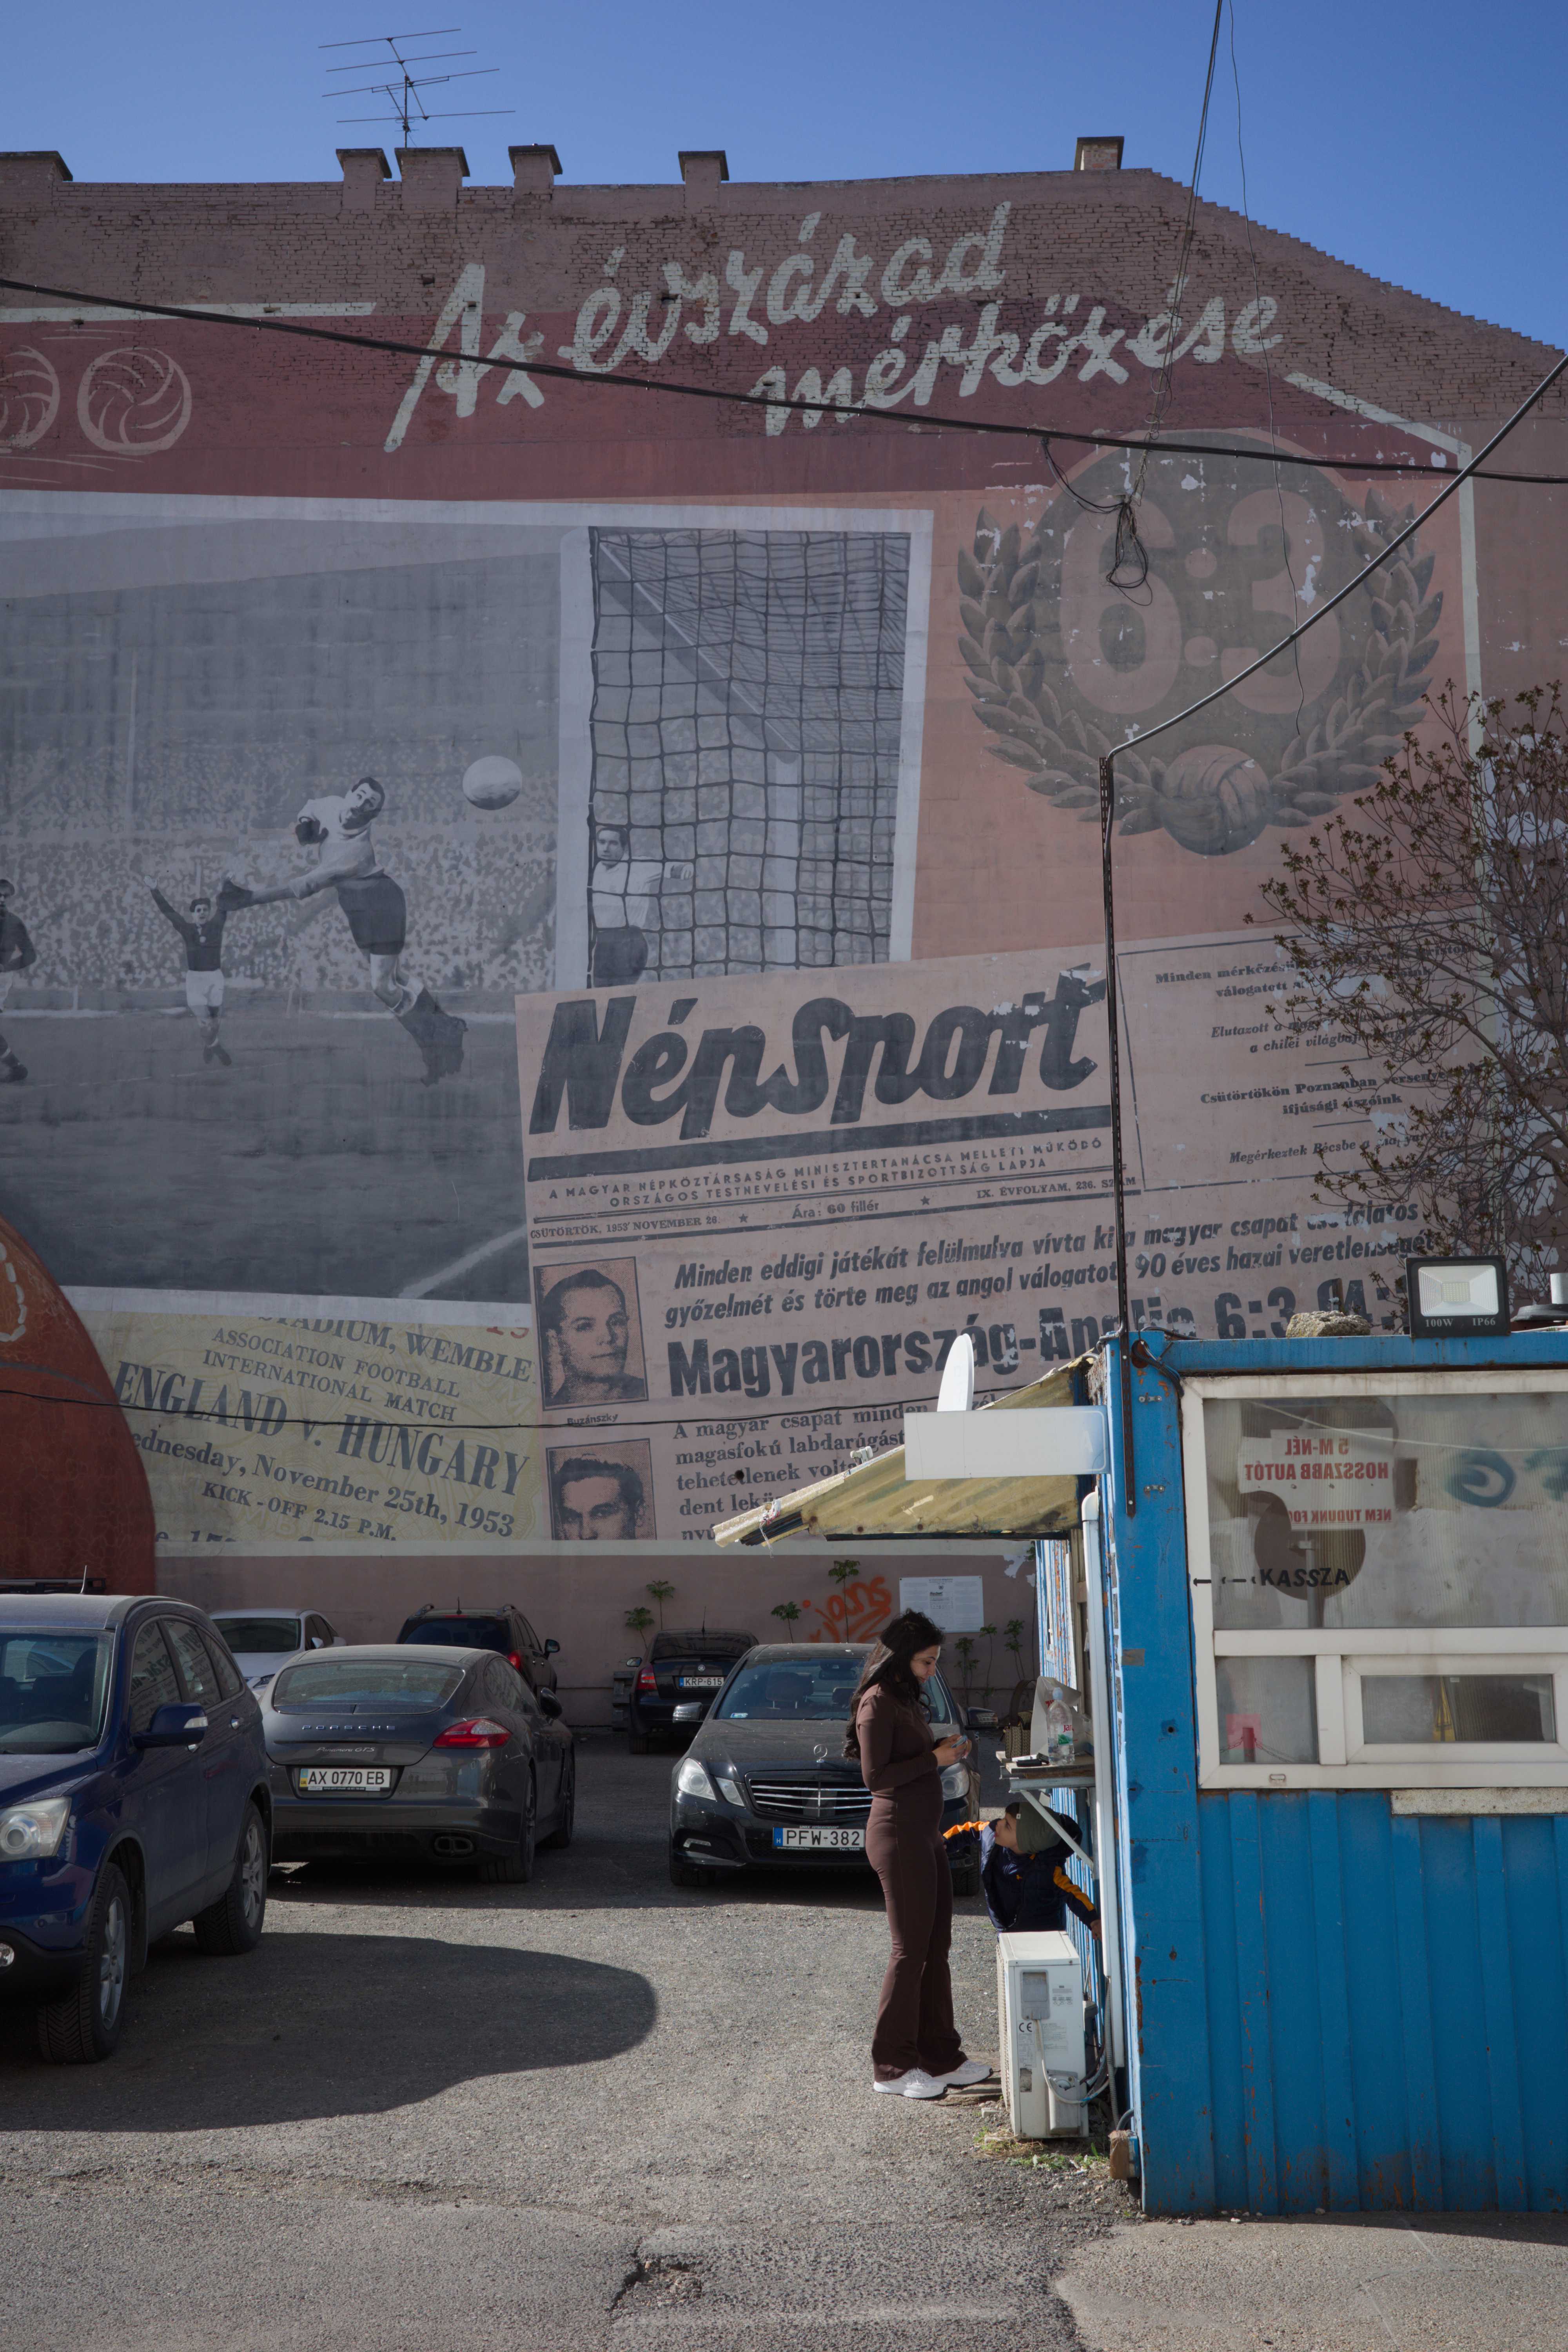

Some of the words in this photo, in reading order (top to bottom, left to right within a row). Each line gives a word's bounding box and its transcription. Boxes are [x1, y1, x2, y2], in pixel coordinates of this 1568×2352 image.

[383, 263, 544, 452] Az
[1060, 489, 1340, 714] 6:3
[1155, 970, 1212, 984] Minden
[1216, 981, 1287, 998] válogatott
[1211, 1022, 1269, 1038] Elutazott
[1274, 1023, 1283, 1032] a
[1250, 1044, 1258, 1053] a
[1264, 1037, 1299, 1051] chilei
[1200, 1086, 1290, 1104] Csütörtökön
[1295, 1077, 1377, 1094] Poznanban
[1283, 1100, 1338, 1115] ifjúsági
[1346, 1094, 1402, 1109] úszóink
[1230, 1145, 1307, 1165] Megérkeztek
[1312, 1139, 1356, 1154] Bécsbe
[549, 1189, 558, 1199] A
[566, 1183, 630, 1197] MAGYAR
[639, 1167, 786, 1191] NÉPKÖZTÁRSASÁG
[795, 1152, 953, 1177] MINISZTERTANÁCSA
[610, 1189, 699, 1208] ORSZÁGOS
[707, 1179, 815, 1199] TESTNEVELÉSI
[824, 1174, 840, 1188] ÉS
[849, 1161, 991, 1186] SPORTBIZOTTSÁG
[999, 1158, 1046, 1171] LAPJA
[530, 1222, 602, 1239] CSÜTÖRTÖK,
[633, 1217, 702, 1231] NOVEMBER
[793, 1203, 822, 1219] Ára:
[827, 1203, 846, 1214] 60
[850, 1200, 879, 1214] fillér
[976, 1188, 995, 1199] IX.
[1000, 1181, 1072, 1196] ÉVFOLYAM,
[1076, 1179, 1097, 1190] 236.
[1101, 1176, 1136, 1189] SZM
[673, 1259, 752, 1290] Minden
[760, 1252, 824, 1281] eddigi
[829, 1247, 908, 1280] játékát
[1033, 1232, 1086, 1255] vívta
[1094, 1225, 1115, 1250] ki
[1144, 1221, 1223, 1247] magyar
[1230, 1212, 1299, 1239] csapat
[664, 1293, 773, 1329] győzelmét
[781, 1289, 805, 1312] és
[814, 1285, 867, 1310] törte
[875, 1283, 918, 1307] meg
[927, 1280, 950, 1299] az
[956, 1267, 1014, 1299] angol
[1019, 1260, 1120, 1290] válogatot
[1135, 1252, 1166, 1279] 90
[1171, 1250, 1221, 1276] éves
[1227, 1243, 1283, 1271] hazai
[1425, 1318, 1454, 1327] 100W
[1472, 1317, 1496, 1326] IP66
[212, 1327, 346, 1370] ASSOCIATION
[354, 1359, 461, 1398] FOOTBALL
[405, 1331, 534, 1384] WEMBLE
[203, 1349, 372, 1402] INTERNATIONAL
[384, 1392, 457, 1422] MATCH
[116, 1361, 287, 1437] ENGLAND
[336, 1414, 530, 1496] HUNGARY
[567, 1413, 618, 1425] Buzánszky
[673, 1423, 688, 1439] A
[696, 1417, 769, 1440] magyar
[780, 1410, 842, 1432] csapat
[675, 1439, 781, 1468] magasfokú
[132, 1429, 246, 1477] ednesday,
[252, 1454, 380, 1503] November
[384, 1486, 448, 1526] 25th,
[455, 1503, 515, 1537] 1953
[202, 1482, 252, 1506] KICK
[268, 1497, 307, 1519] OFF
[314, 1508, 351, 1530] 2.15
[358, 1518, 396, 1541] P.M.
[679, 1497, 724, 1516] dent
[1259, 1567, 1351, 1588] KASSZA
[308, 1771, 327, 1785] AX
[332, 1771, 363, 1785] 0770
[367, 1771, 385, 1785] EB
[786, 1830, 860, 1846] PFW-382
[1019, 2022, 1033, 2033] CE
